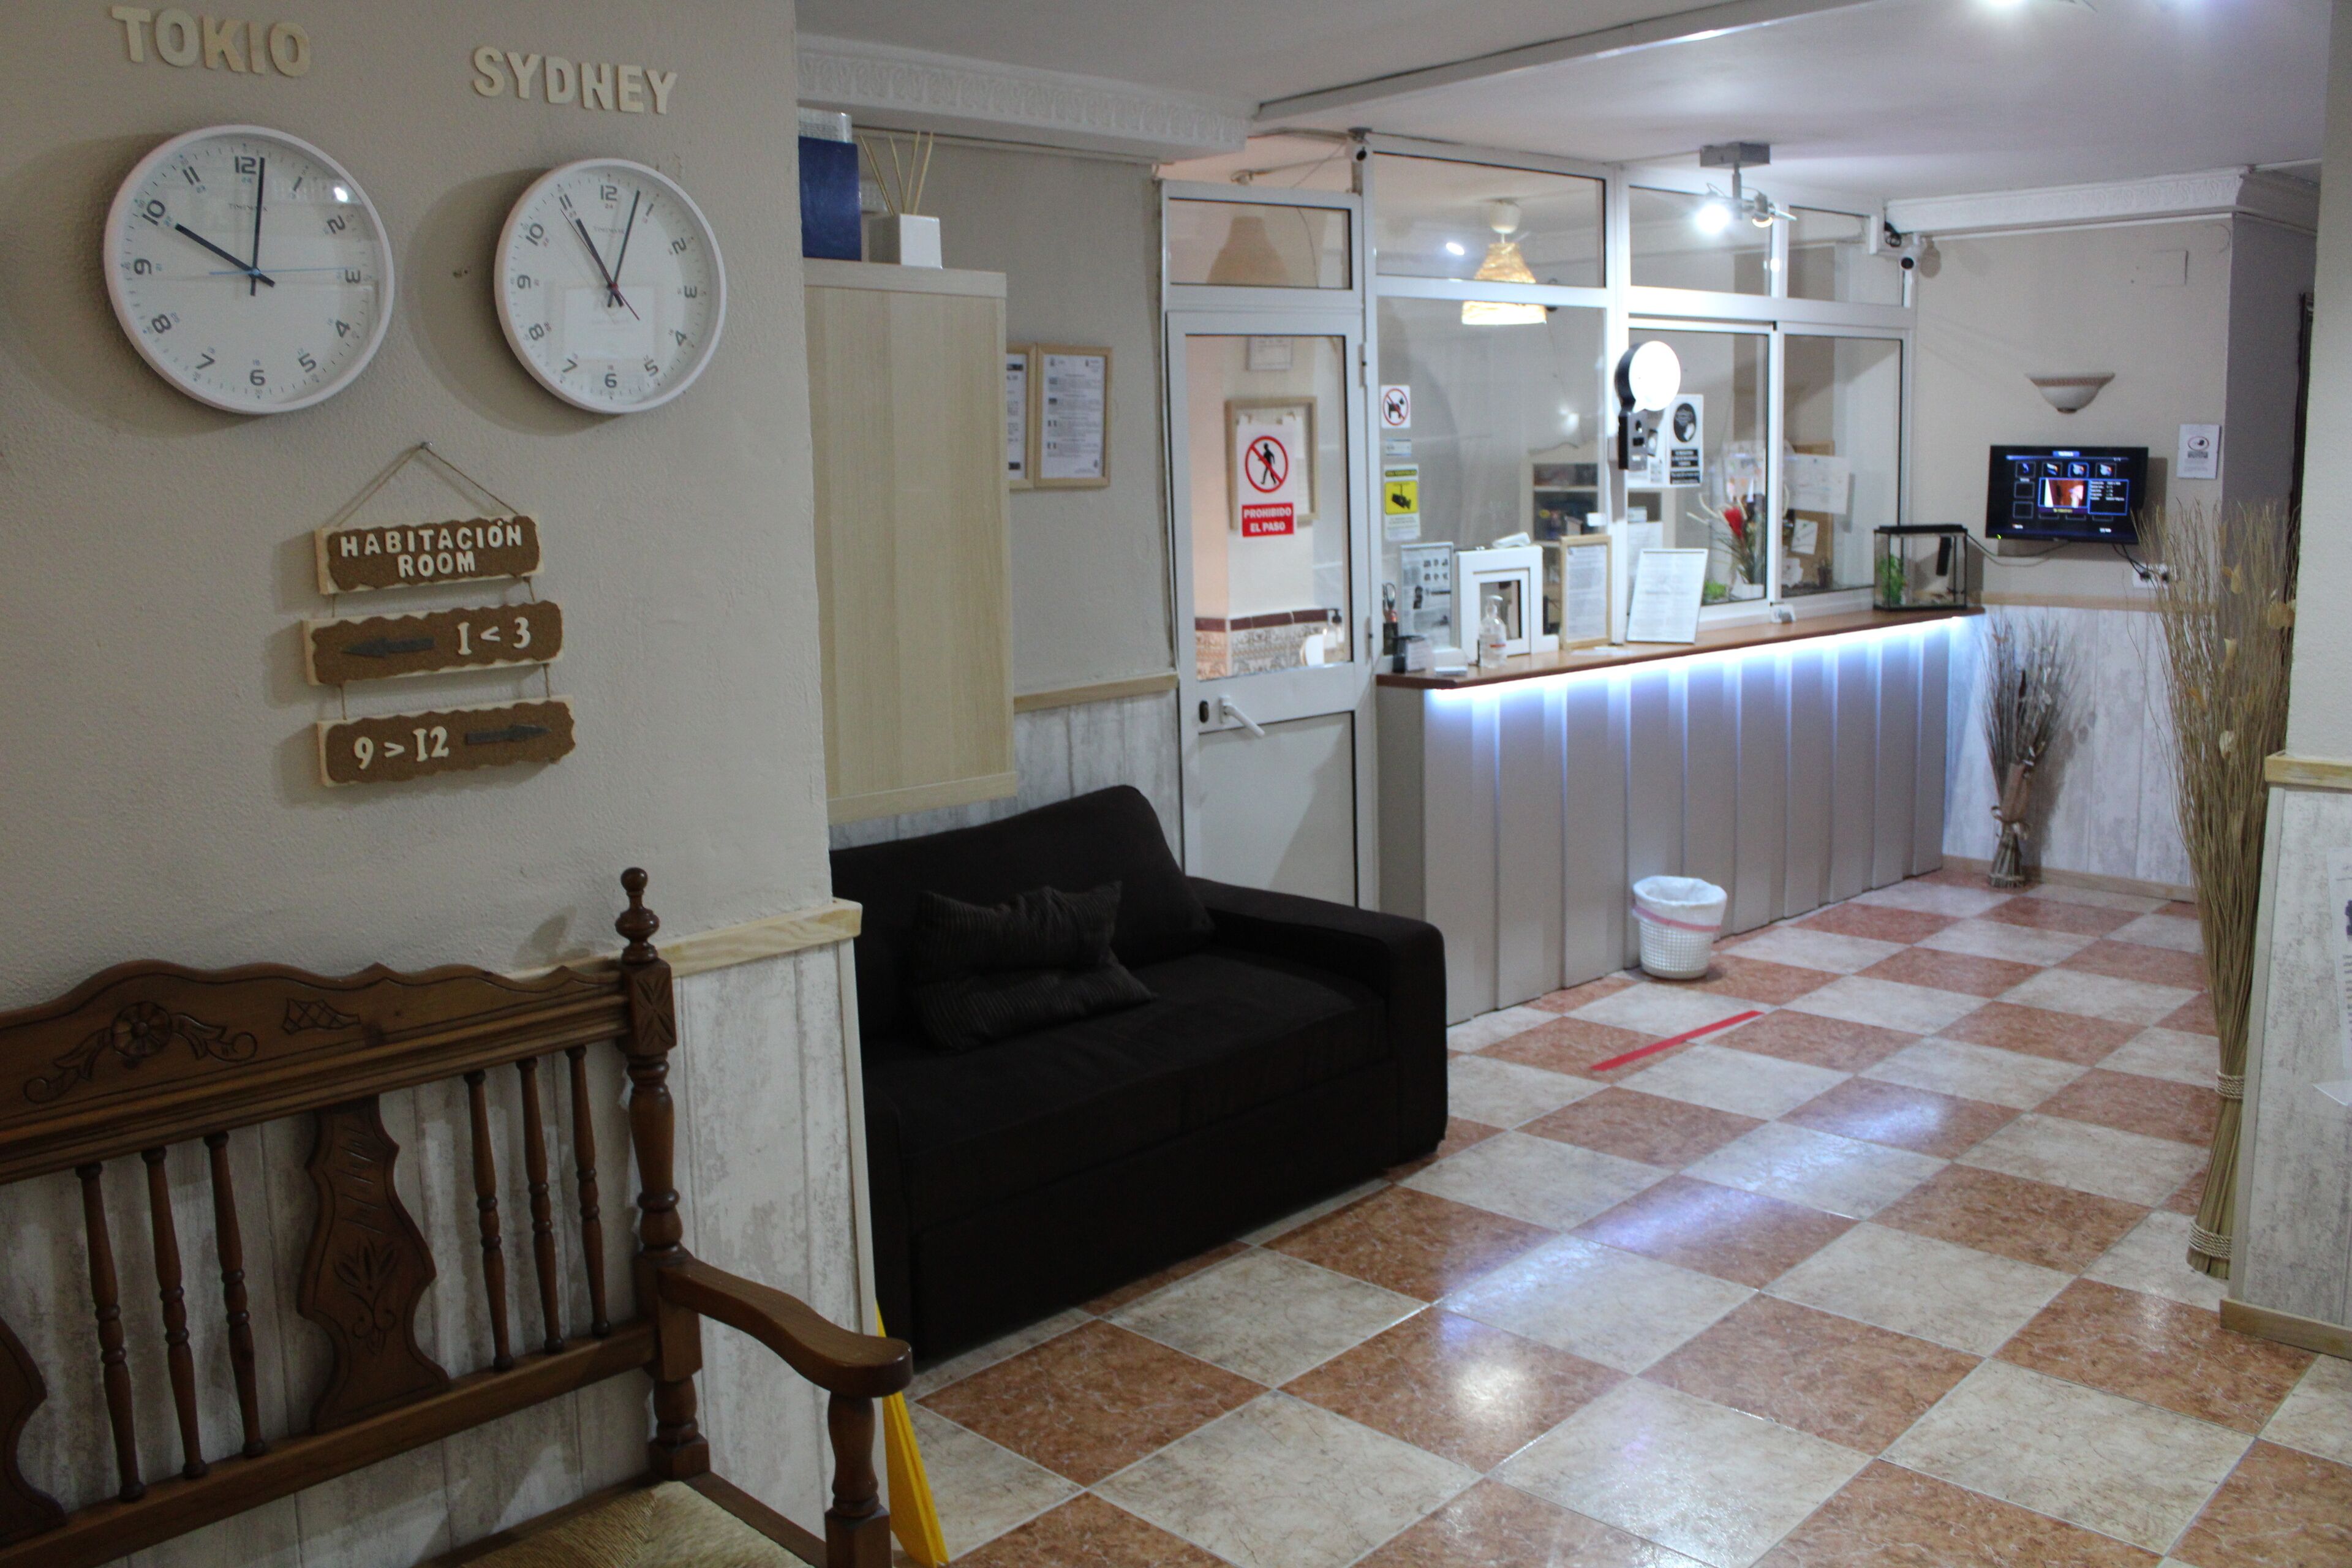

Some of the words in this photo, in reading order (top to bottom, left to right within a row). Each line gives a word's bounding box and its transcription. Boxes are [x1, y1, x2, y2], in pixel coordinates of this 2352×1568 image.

[111, 4, 310, 78] TOKIO
[472, 45, 677, 115] SYDNEY
[235, 156, 257, 174] 12
[182, 165, 201, 186] 11
[292, 176, 302, 191] 1
[559, 193, 573, 211] 11
[600, 185, 617, 201] 12
[142, 200, 165, 227] 10
[646, 203, 654, 216] 1
[326, 215, 345, 234] 2
[526, 223, 544, 246] 10
[671, 237, 687, 254] 2
[134, 258, 152, 275] 9
[345, 270, 361, 284] 3
[517, 275, 531, 288] 9
[684, 285, 698, 298] 3
[151, 314, 172, 334] 8
[335, 320, 350, 338] 4
[529, 323, 545, 341] 8
[675, 330, 687, 346] 4
[196, 353, 215, 370] 7
[298, 353, 317, 372] 5
[561, 358, 578, 372] 7
[644, 359, 658, 377] 5
[250, 369, 265, 386] 6
[605, 374, 617, 388] 6
[1243, 507, 1292, 518] PROHIBIDO
[1250, 522, 1261, 533] EL
[1262, 521, 1286, 532] PASO
[340, 521, 521, 557] HABITACIÓN
[398, 551, 475, 578] ROOM
[513, 617, 531, 649] 3
[354, 737, 374, 770] 9
[412, 726, 450, 762] 12
